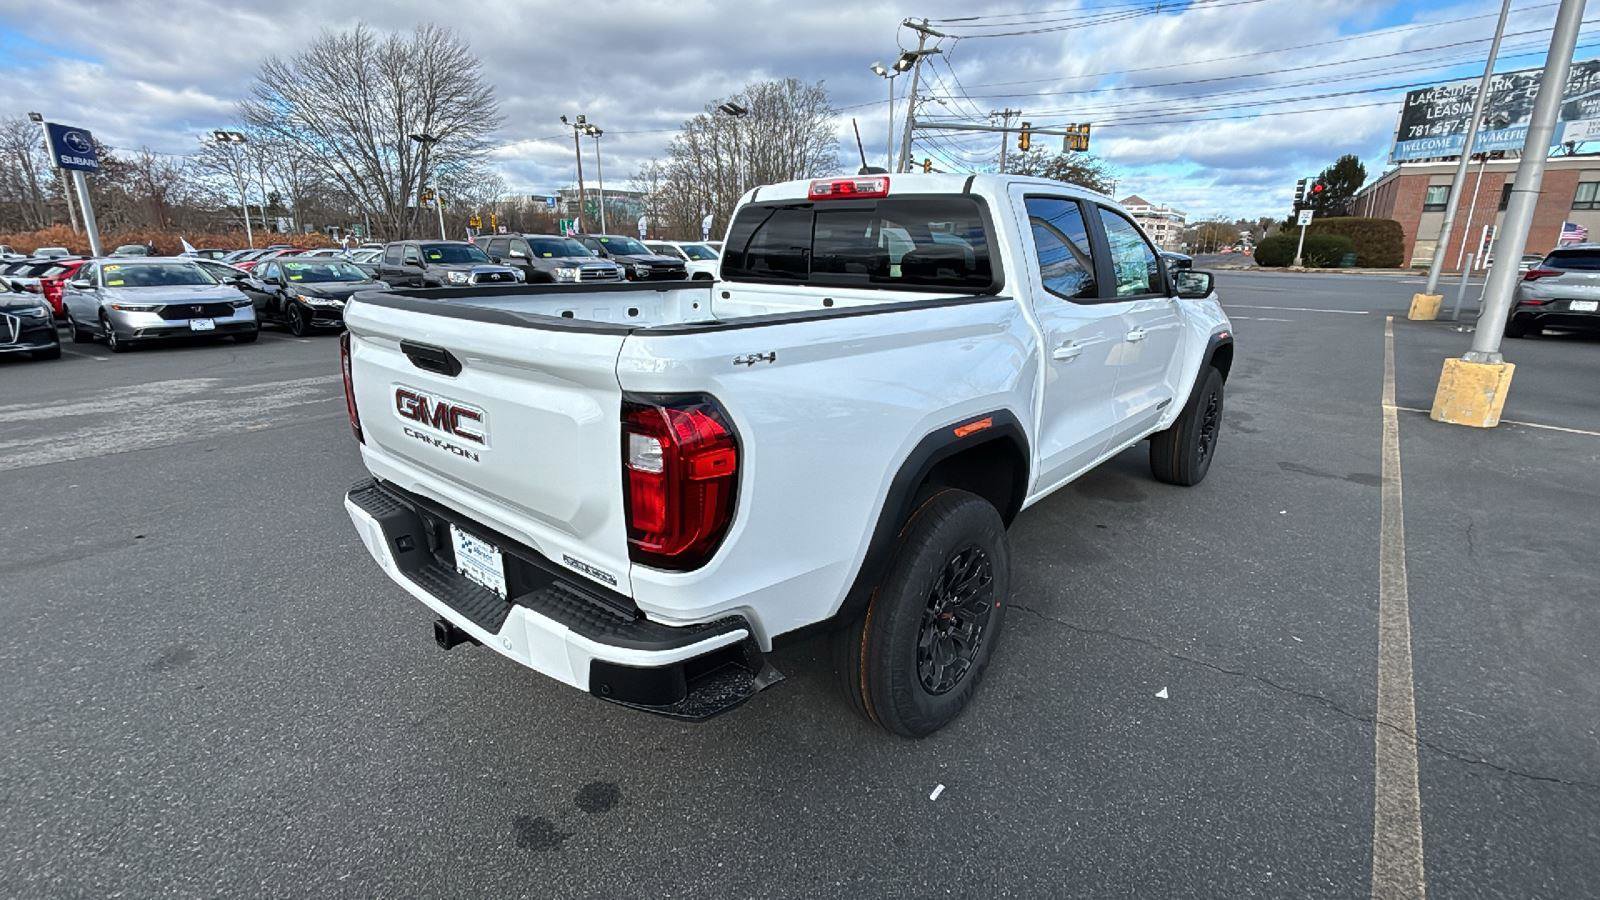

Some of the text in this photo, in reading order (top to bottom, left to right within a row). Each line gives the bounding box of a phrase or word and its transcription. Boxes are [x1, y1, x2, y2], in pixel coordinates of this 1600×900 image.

[1426, 101, 1487, 119] LEASIN
[1402, 138, 1452, 152] WELCOME
[1479, 127, 1526, 143] WAKEFIE
[60, 154, 98, 168] SUBARU
[395, 386, 486, 446] GMC
[403, 426, 480, 462] CANYON
